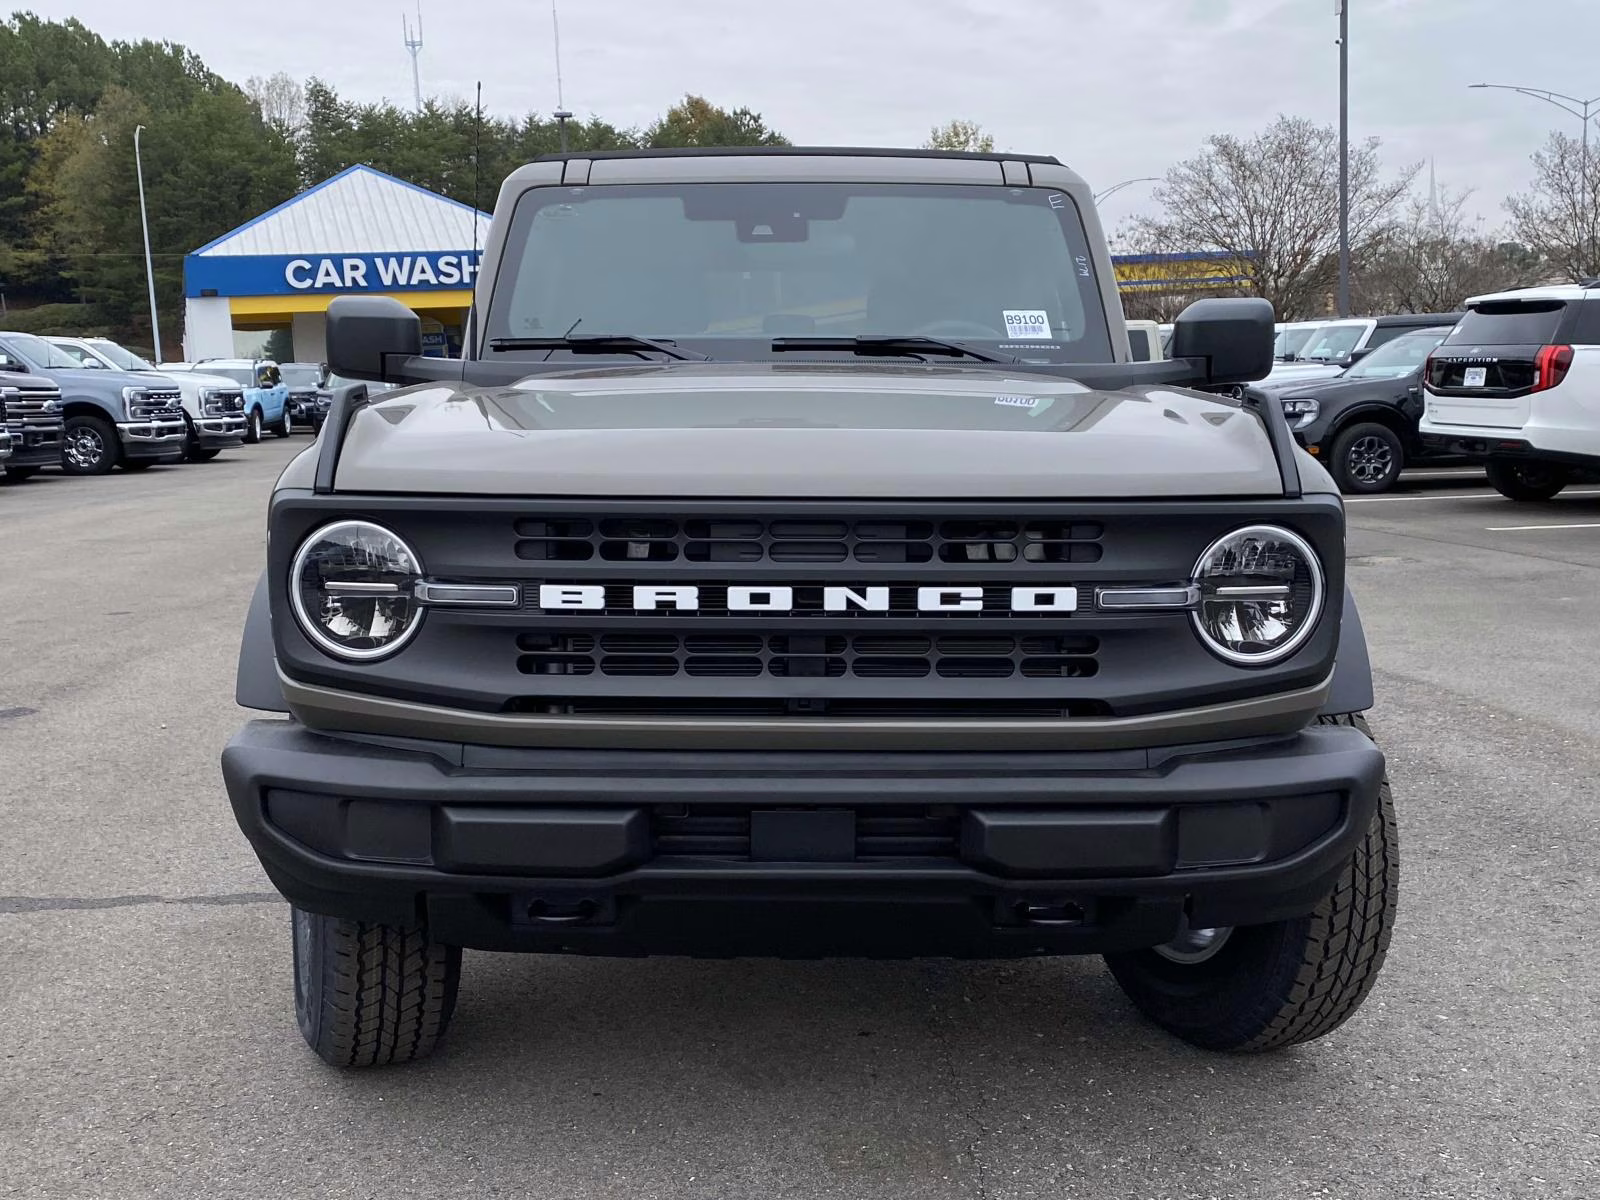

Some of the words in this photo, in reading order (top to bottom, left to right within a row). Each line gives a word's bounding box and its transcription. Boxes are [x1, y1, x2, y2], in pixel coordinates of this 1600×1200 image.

[285, 258, 368, 289] CAR
[375, 255, 484, 286] WASH
[1006, 314, 1045, 325] B9100
[422, 334, 443, 345] ASH
[539, 584, 1078, 612] BRONCO
